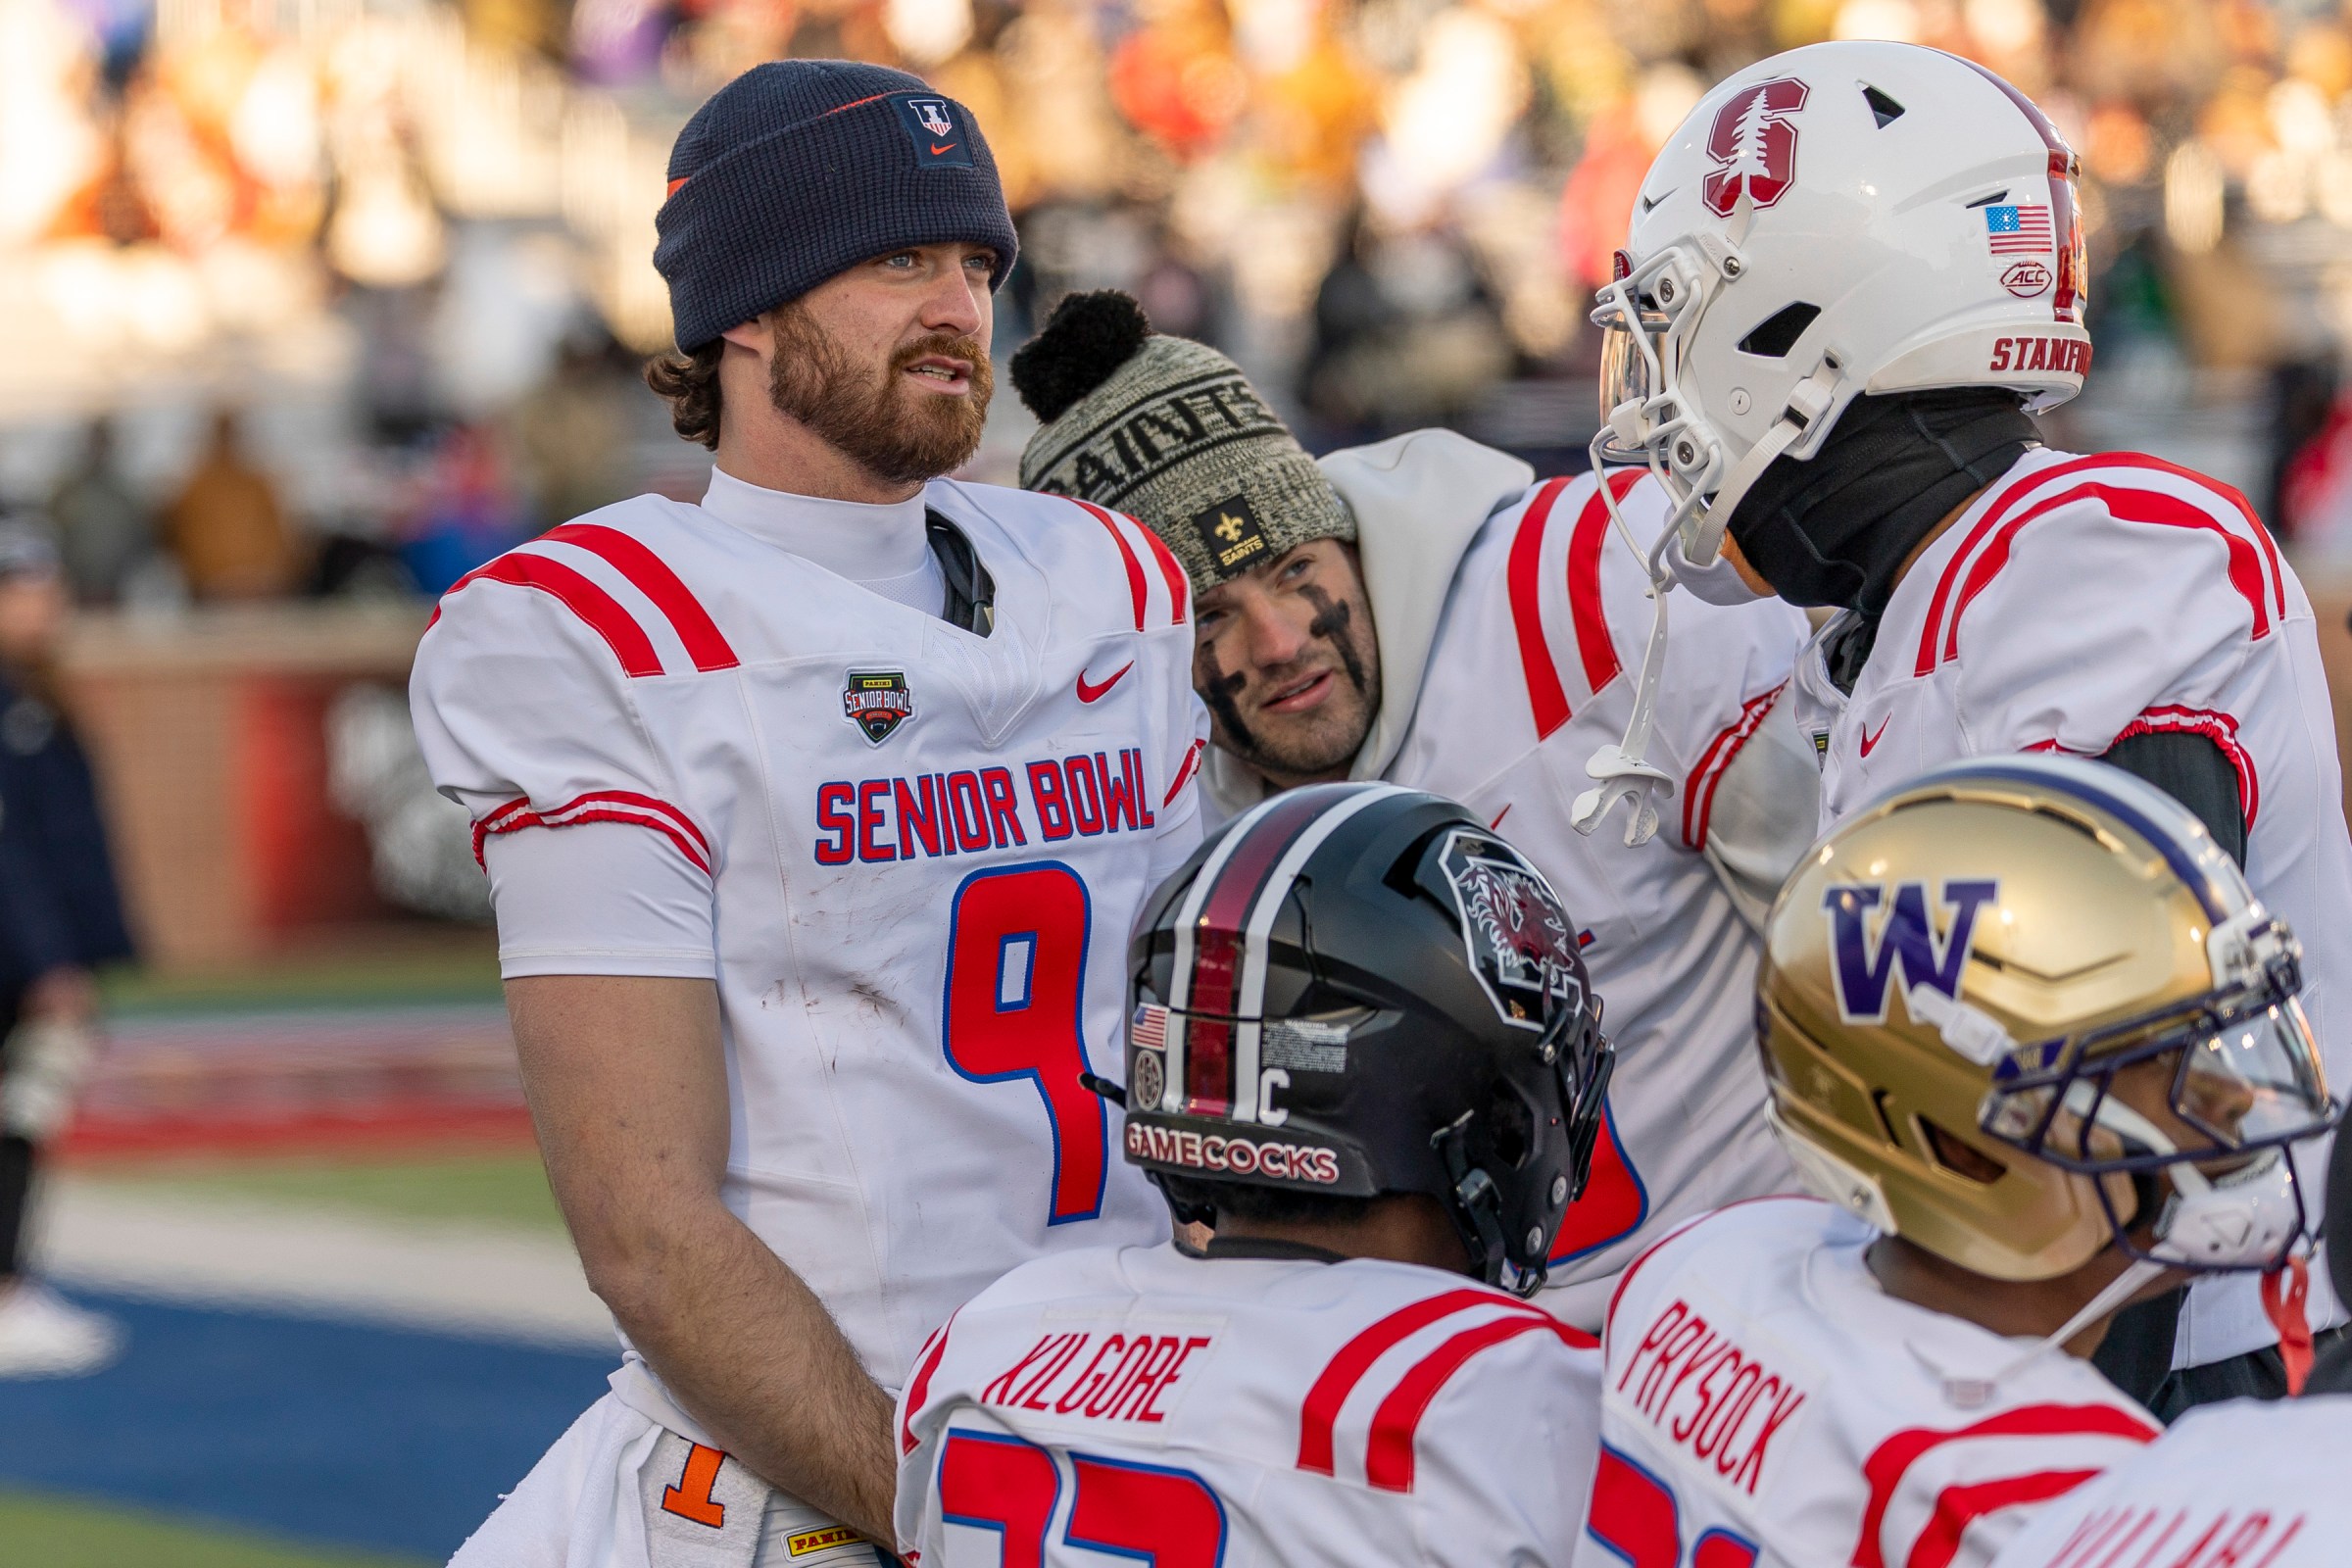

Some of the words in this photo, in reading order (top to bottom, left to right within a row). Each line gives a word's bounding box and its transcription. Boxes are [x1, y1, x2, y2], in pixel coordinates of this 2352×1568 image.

[2009, 270, 2045, 283] ACC
[1222, 539, 1264, 565] SAINTS
[845, 690, 882, 713] SENIOR
[883, 689, 910, 712] BOWL
[814, 765, 1027, 865] SENIOR
[1025, 748, 1154, 842] BOWL
[1820, 876, 2001, 1025] W
[942, 859, 1108, 1227] 9
[1258, 1067, 1291, 1127] C
[1128, 1122, 1339, 1183] GAMECOCKS
[980, 1332, 1211, 1423] KILGORE
[1616, 1298, 1806, 1497] PRYSOCK
[795, 1530, 858, 1550] PANI
